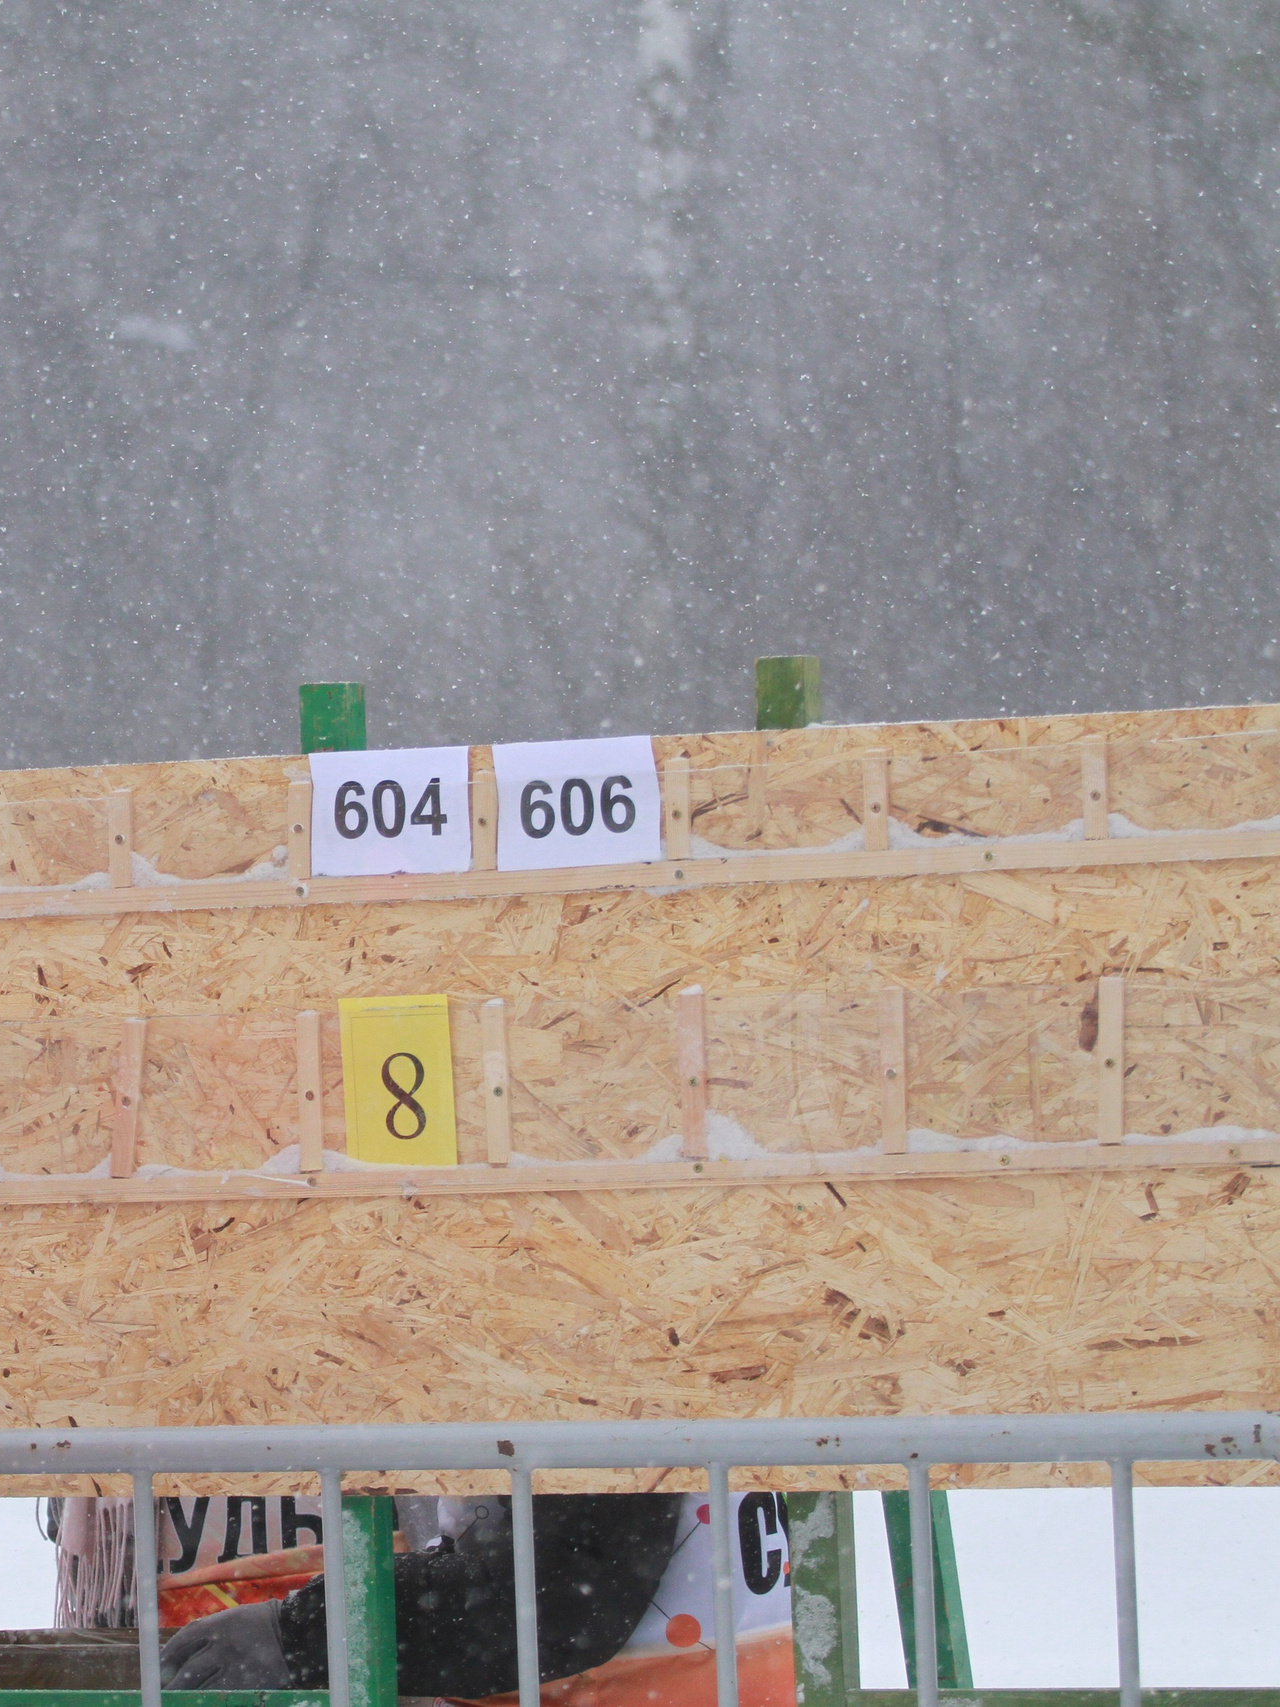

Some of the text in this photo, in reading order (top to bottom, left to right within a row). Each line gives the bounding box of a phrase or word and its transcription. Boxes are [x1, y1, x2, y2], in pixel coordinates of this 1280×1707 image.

[335, 777, 448, 839] 604
[520, 775, 636, 839] 606
[381, 1052, 427, 1140] 8
[157, 1496, 381, 1575] УДЬ
